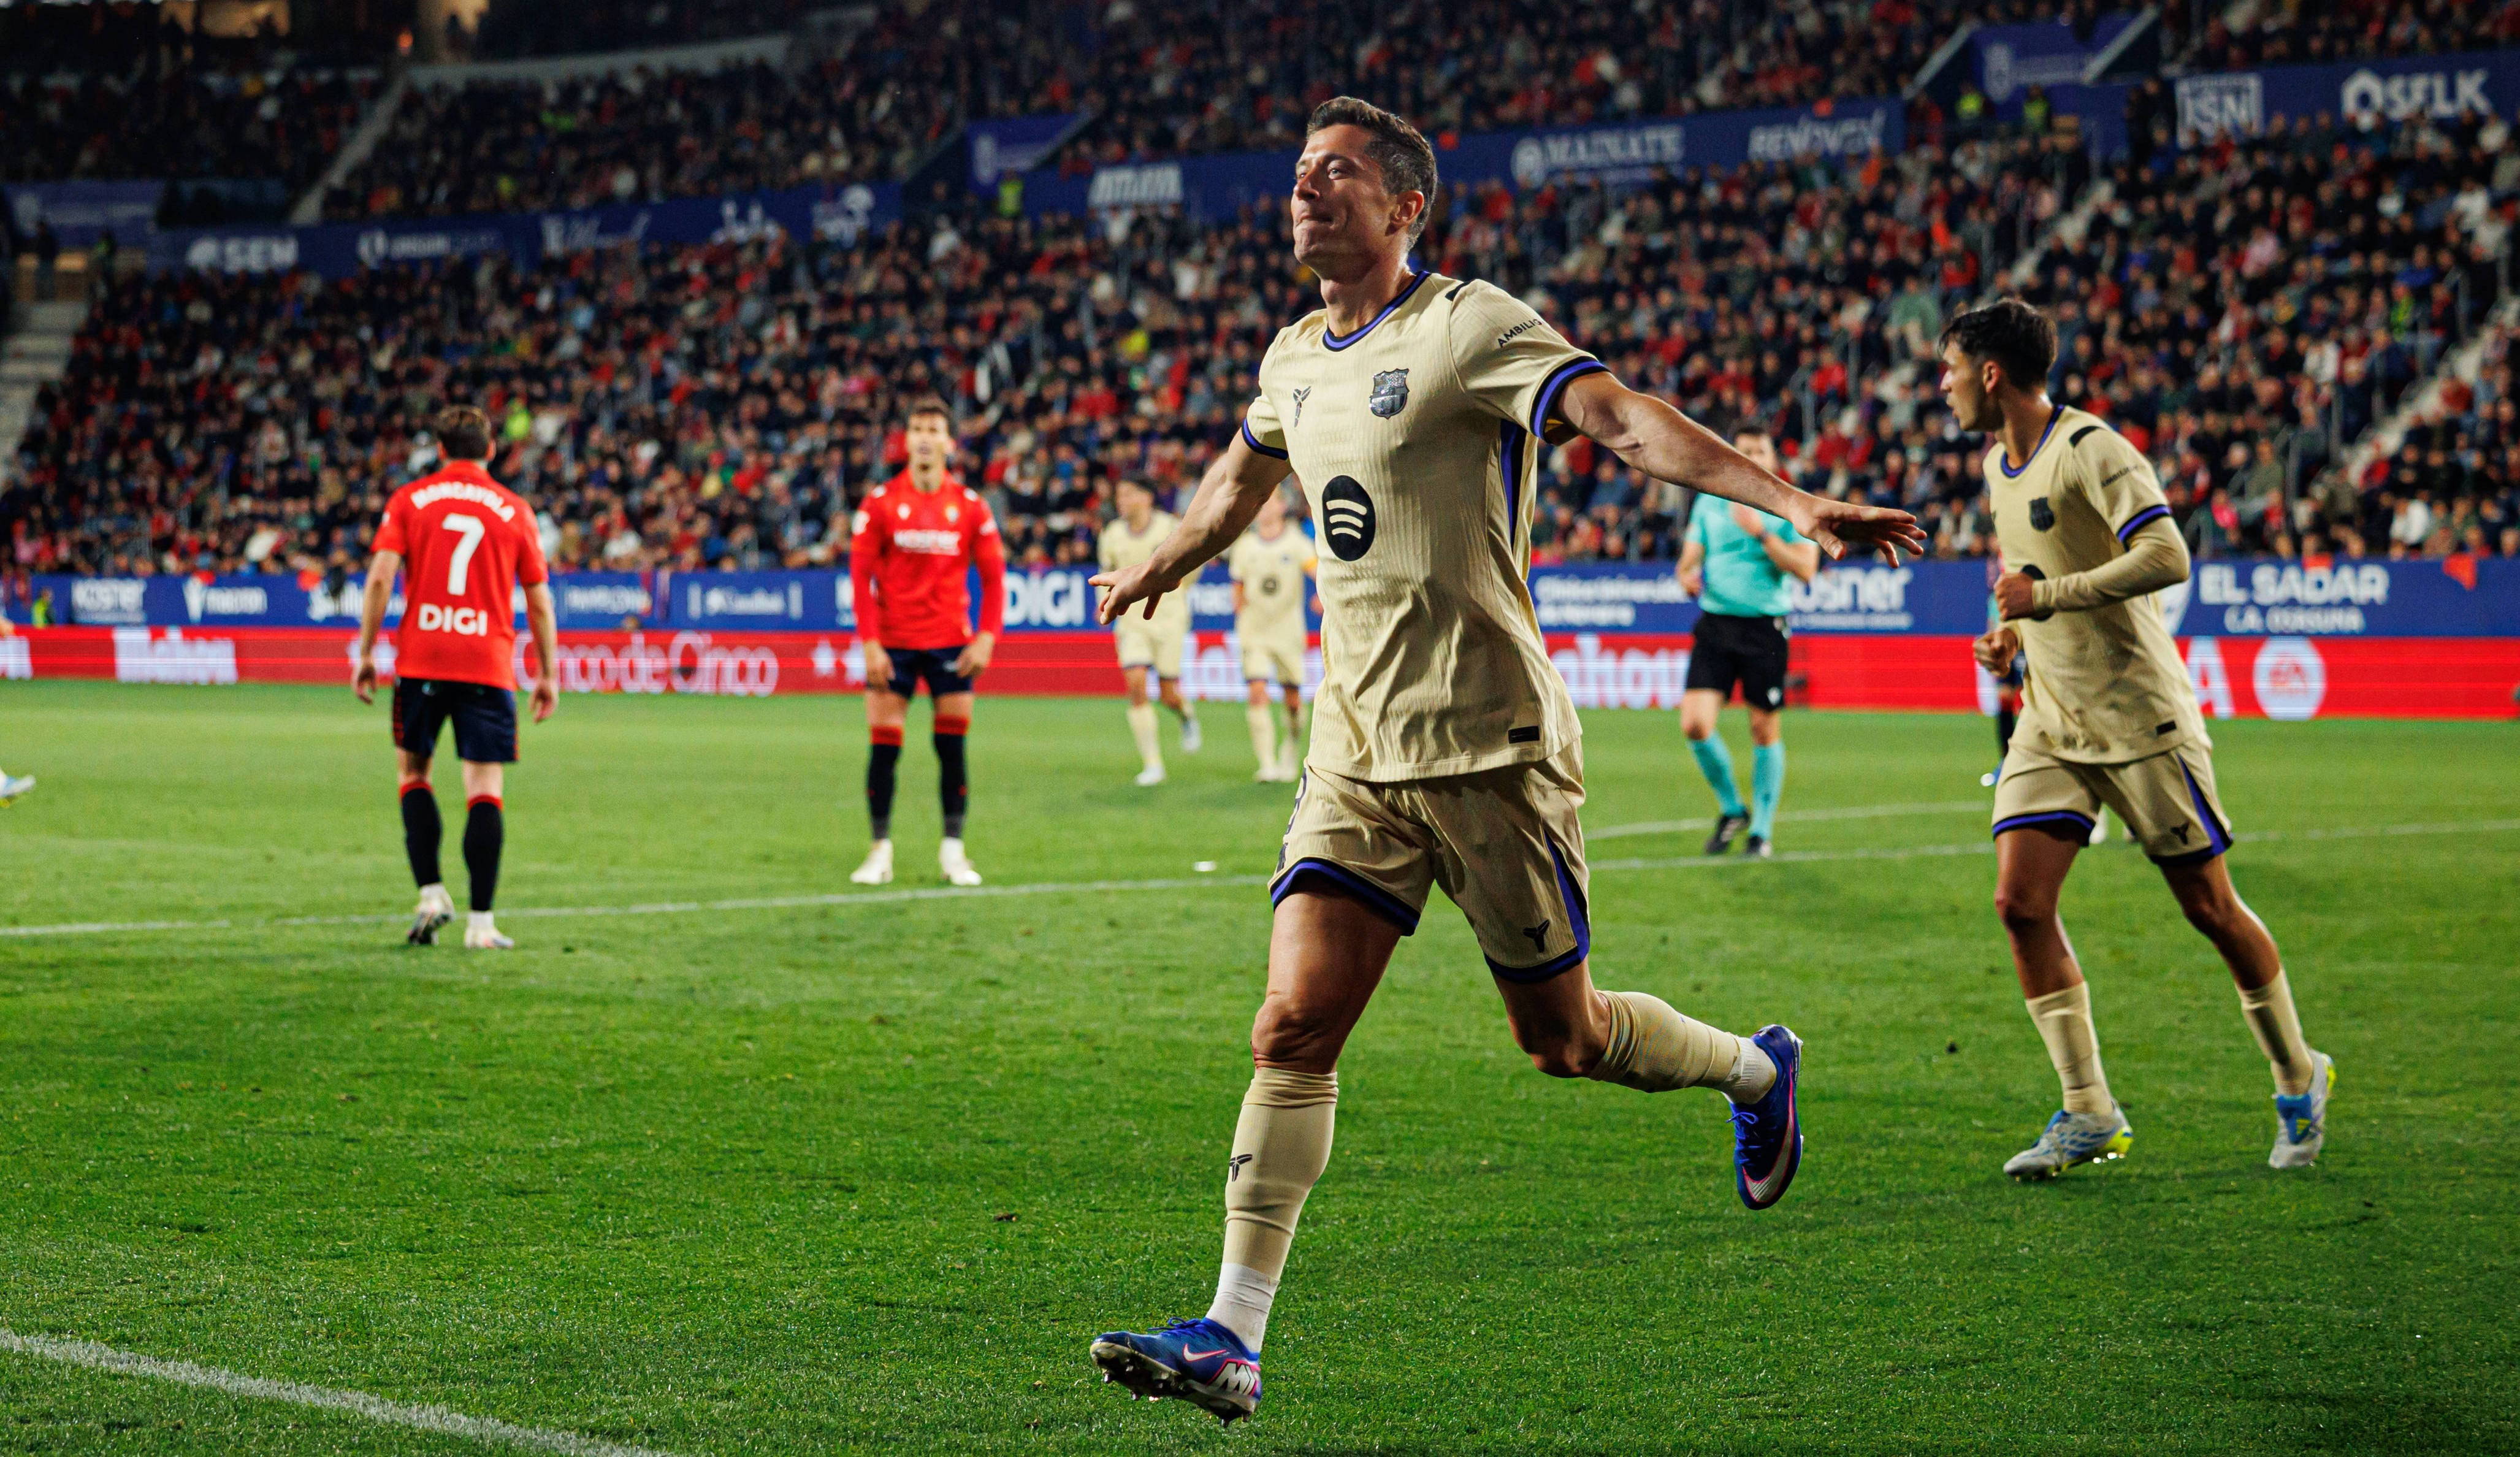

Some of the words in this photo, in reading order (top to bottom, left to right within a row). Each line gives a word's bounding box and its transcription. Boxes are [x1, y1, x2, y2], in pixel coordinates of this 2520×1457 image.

[441, 513, 485, 595] 7
[1003, 571, 1086, 625] DIGI
[2199, 564, 2248, 605] EL
[2251, 564, 2390, 605] SADAR
[418, 603, 488, 637] DIGI
